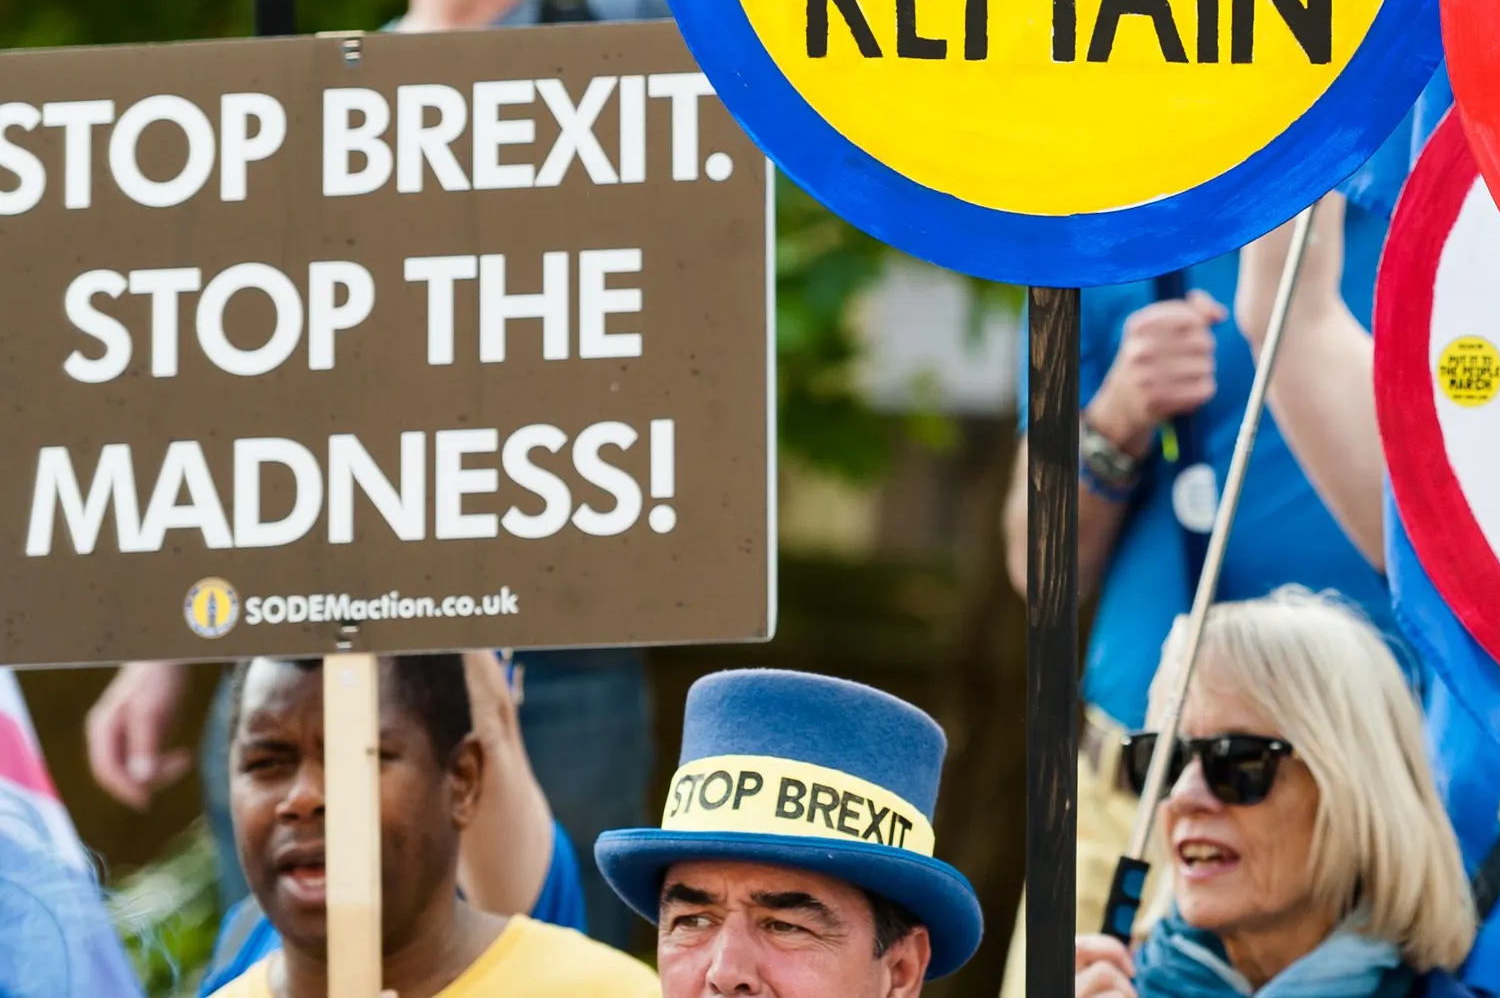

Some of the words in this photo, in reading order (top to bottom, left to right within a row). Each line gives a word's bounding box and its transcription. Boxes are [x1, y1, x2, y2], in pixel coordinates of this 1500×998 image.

[0, 92, 287, 216] STOP
[322, 71, 734, 197] BREXIT.
[63, 262, 375, 383] STOP
[404, 247, 643, 365] THE
[25, 418, 677, 557] MADNESS!
[244, 586, 519, 625] SODEMaction.co.uk
[670, 769, 764, 818] STOP
[774, 776, 914, 849] BREXIT
